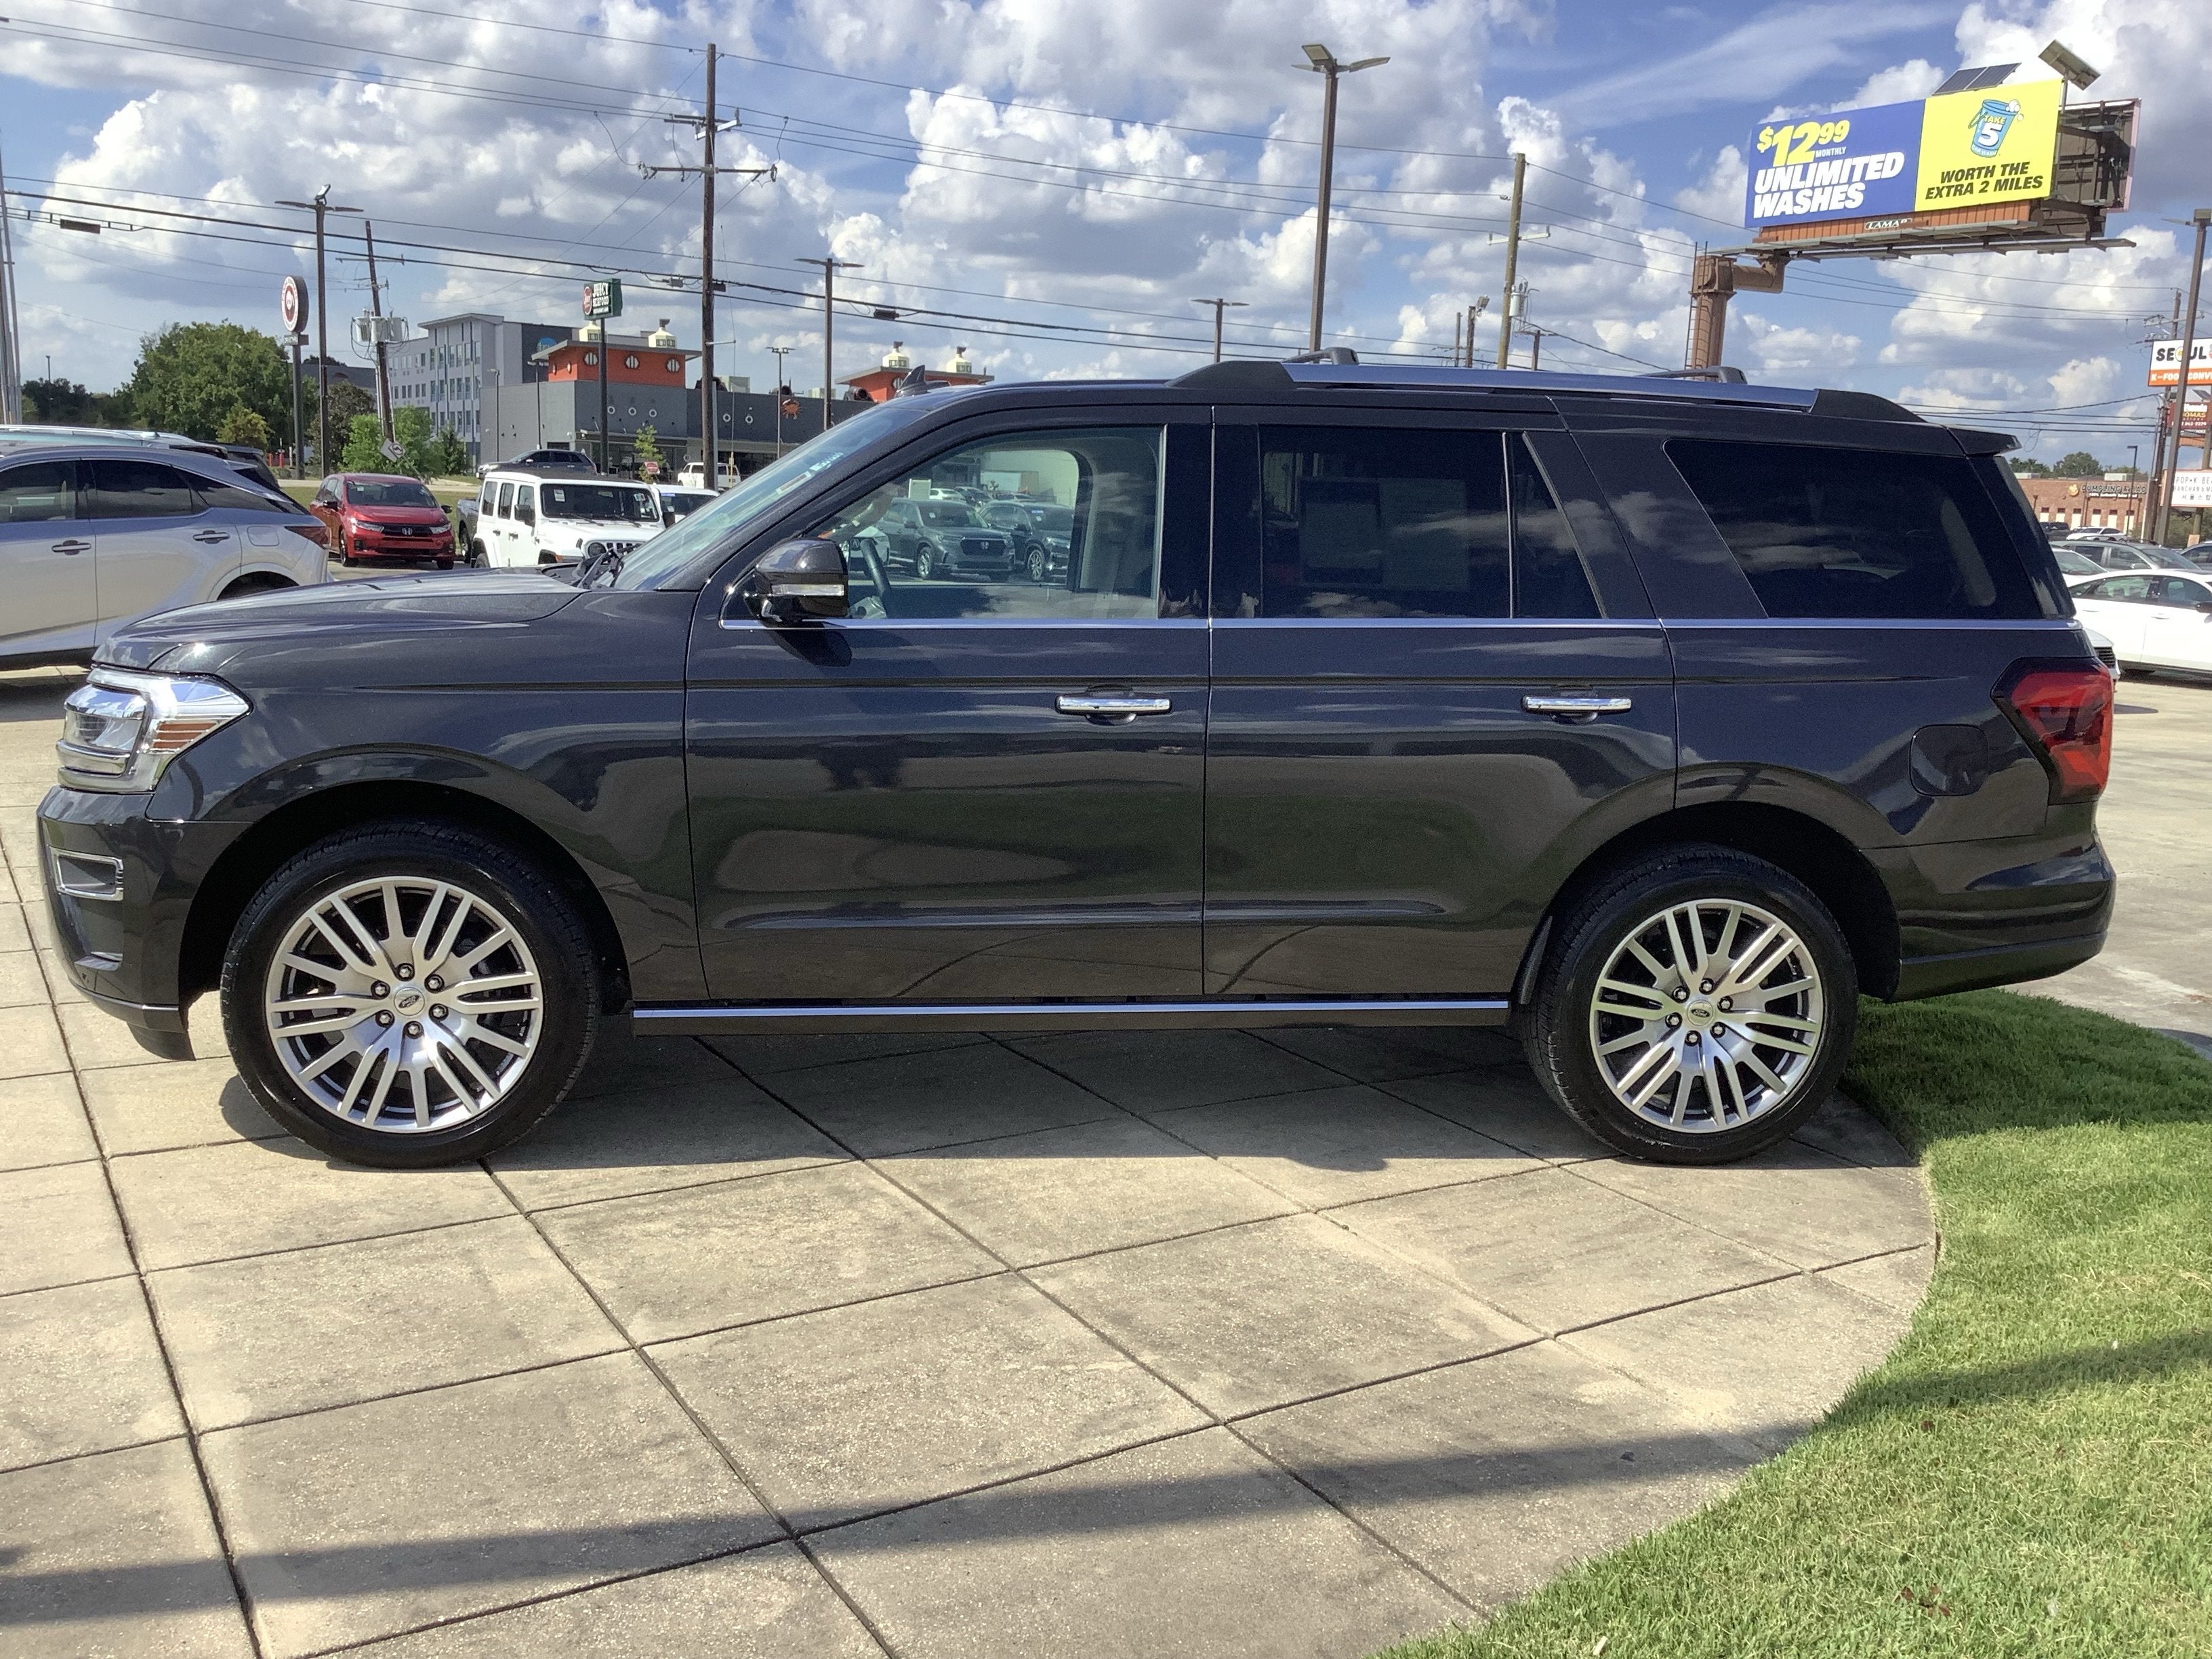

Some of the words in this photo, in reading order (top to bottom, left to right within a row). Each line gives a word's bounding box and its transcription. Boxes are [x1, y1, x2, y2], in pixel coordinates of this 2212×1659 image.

[1984, 115, 2006, 125] TAKE
[1978, 122, 2003, 147] 5
[1816, 146, 1847, 158] MONTHLY
[1755, 152, 1905, 194] UNLIMITED
[1941, 165, 1996, 184] WORTH
[2001, 161, 2030, 176] THE
[1925, 182, 1973, 200] EXTRA
[1978, 180, 1990, 193] 2
[1993, 176, 2043, 192] MILES
[1753, 182, 1866, 219] WASHES
[592, 283, 609, 298] JUICY
[2151, 372, 2179, 382] K-FOO
[2082, 485, 2121, 493] DUMPLING
[1694, 1009, 1708, 1017] Ford
